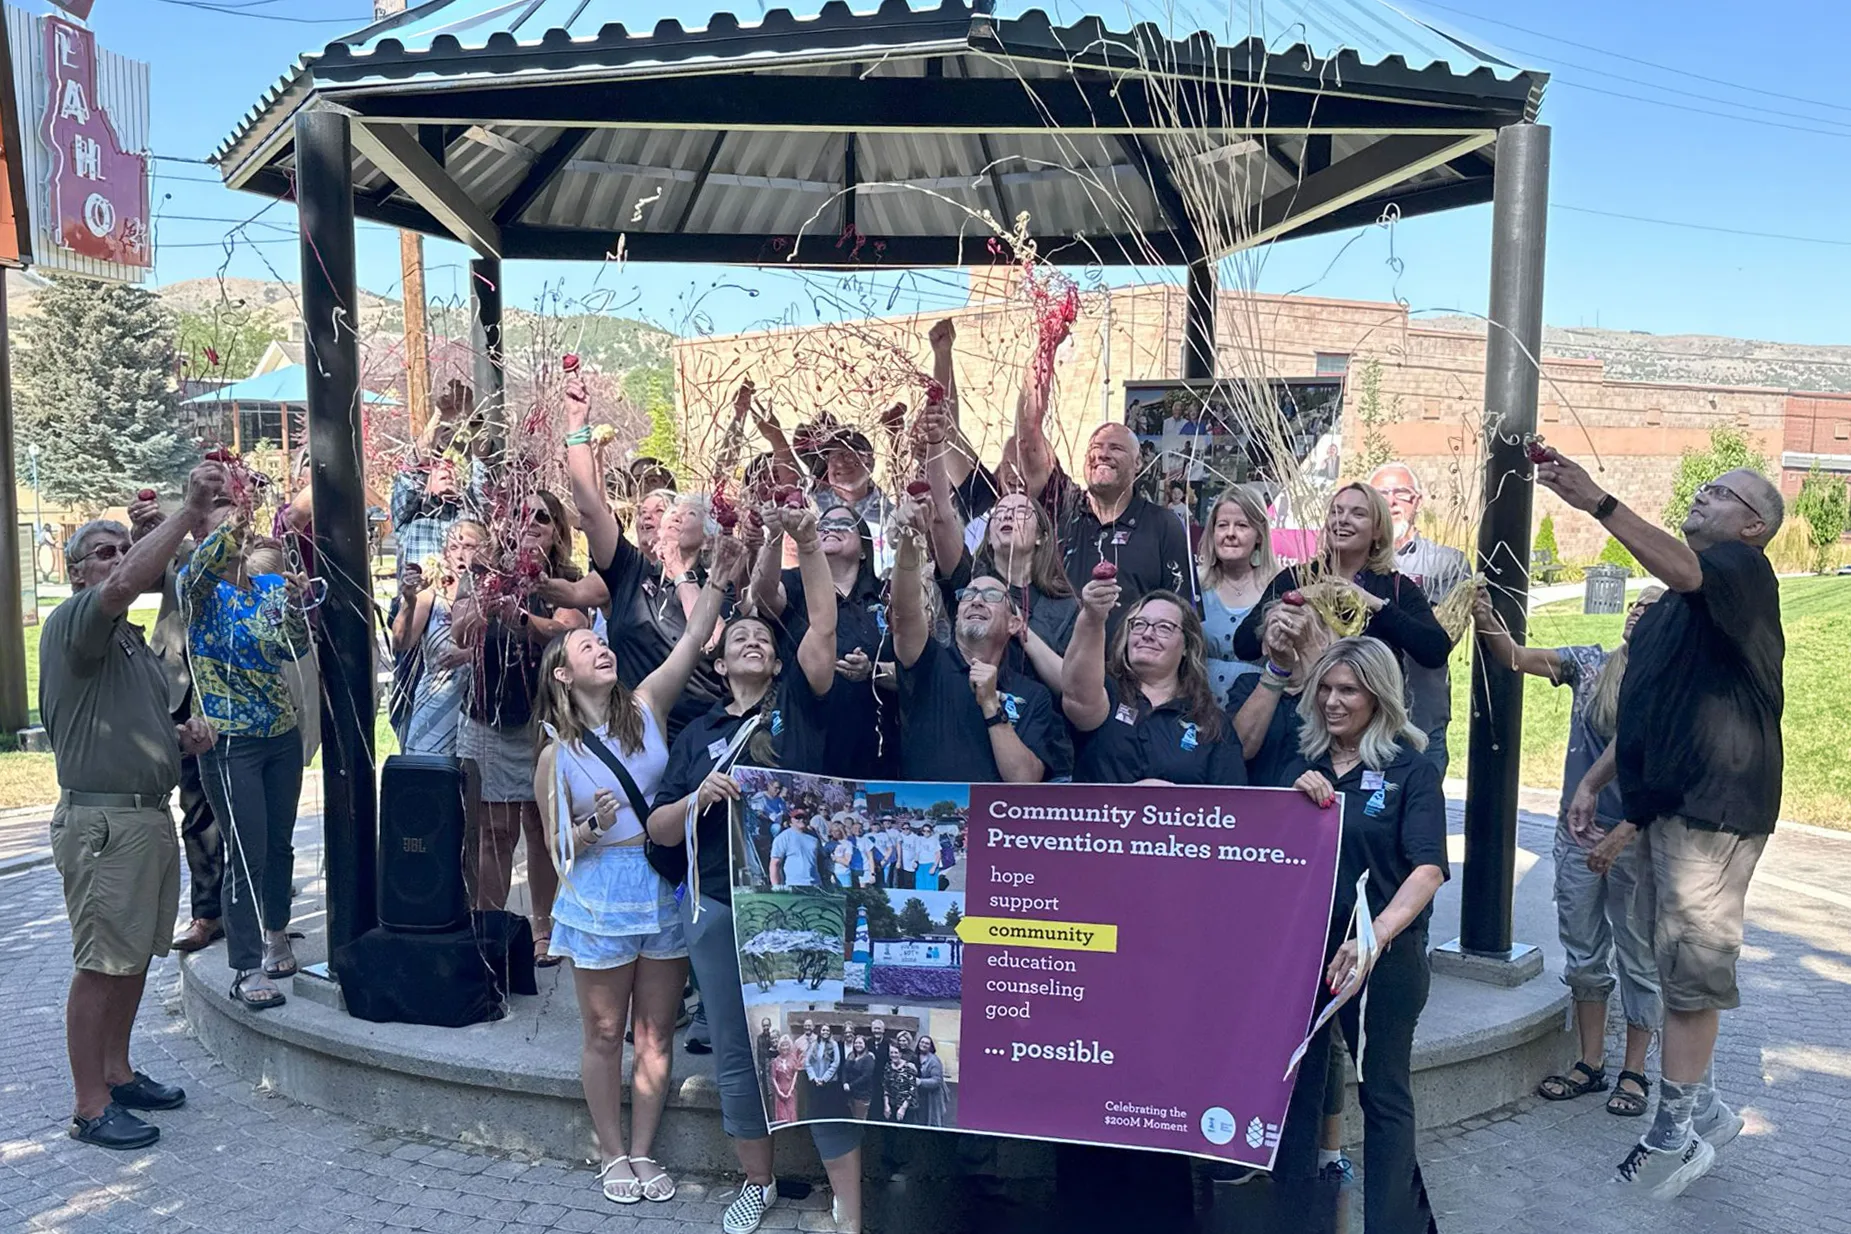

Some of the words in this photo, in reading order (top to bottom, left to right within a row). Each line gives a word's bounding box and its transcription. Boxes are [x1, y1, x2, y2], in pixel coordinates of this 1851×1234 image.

[988, 801, 1136, 828] Community
[1142, 805, 1236, 828] Suicide
[403, 837, 426, 852] JBL
[987, 828, 1125, 853] Prevention
[1130, 835, 1211, 858] makes
[1218, 846, 1306, 865] more...
[990, 865, 1034, 886] hope
[989, 895, 1060, 912] support
[988, 924, 1094, 946] community
[987, 952, 1076, 972] education
[986, 979, 1084, 1001] counseling
[985, 1001, 1030, 1020] good
[1011, 1040, 1114, 1065] possible
[1105, 1101, 1166, 1118] Celebrating
[1169, 1107, 1187, 1119] the
[1104, 1115, 1140, 1128] $200M
[1144, 1117, 1187, 1133] Moment
[1681, 1139, 1699, 1164] HOKA
